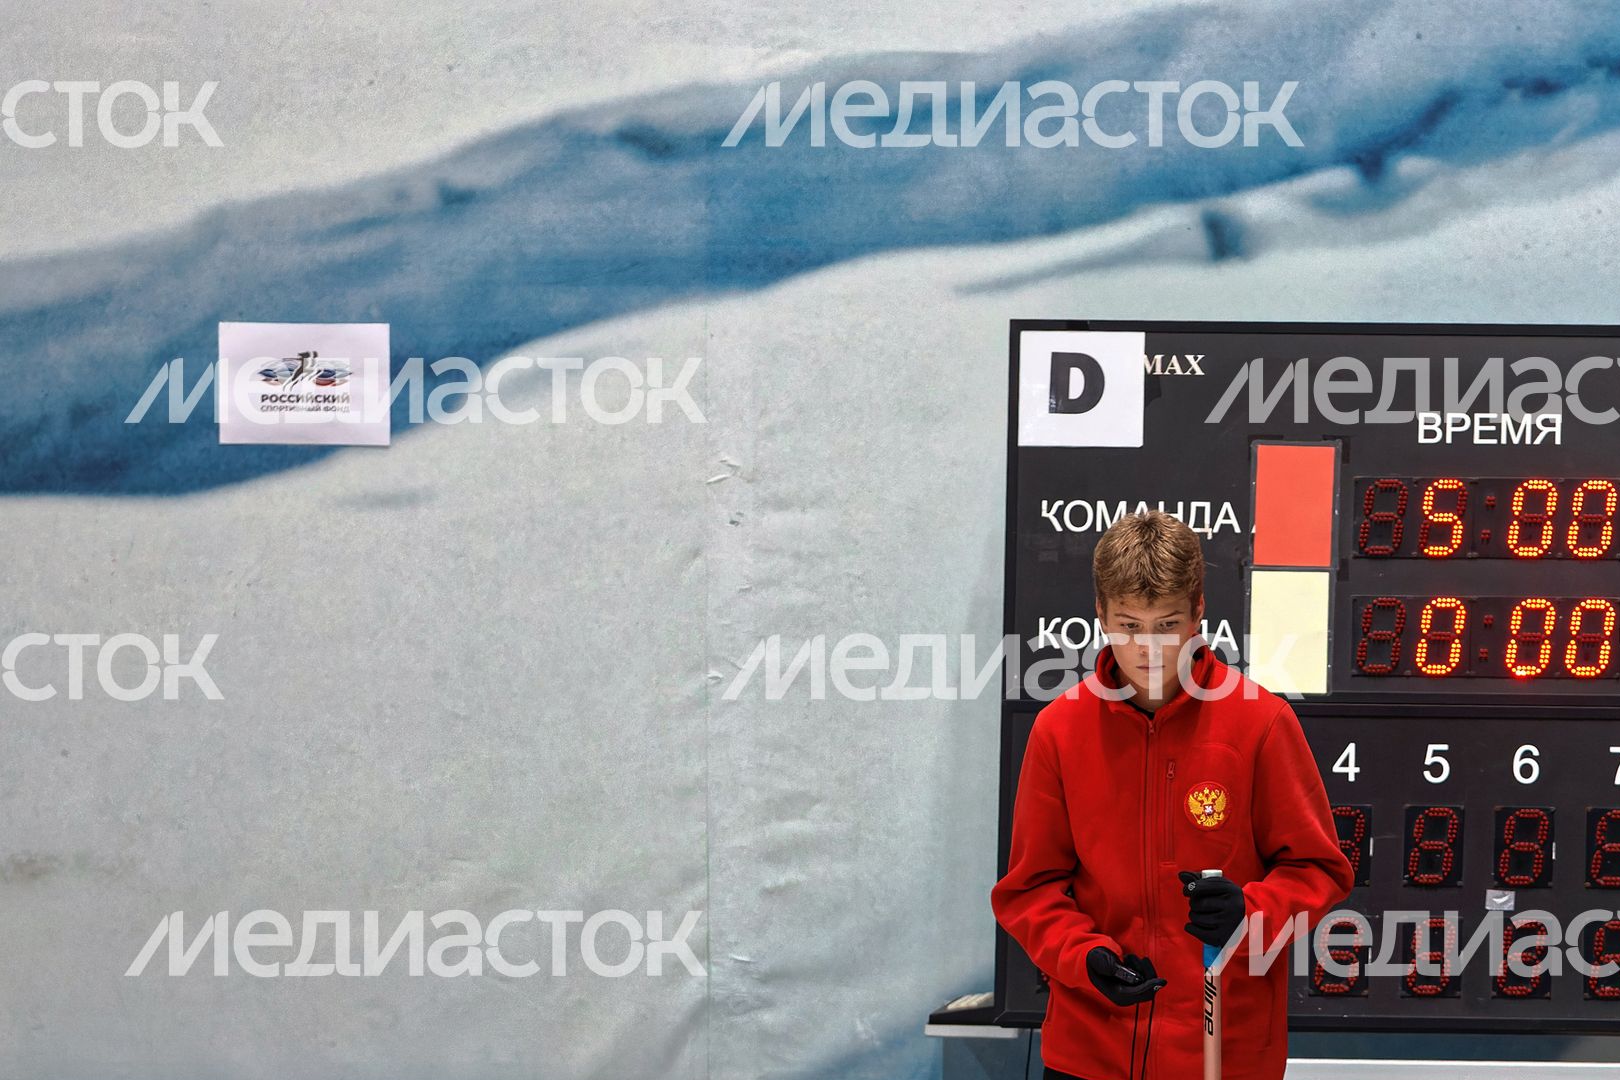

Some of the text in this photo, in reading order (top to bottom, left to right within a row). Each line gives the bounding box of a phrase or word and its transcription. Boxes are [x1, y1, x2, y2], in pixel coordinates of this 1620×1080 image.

[260, 392, 350, 404] РОССИЙСКИЙ
[1049, 352, 1105, 414] D
[1417, 413, 1562, 445] ВРЕМЯ
[1332, 742, 1360, 781] 4
[1423, 743, 1450, 784] 5
[1512, 745, 1540, 785] 6
